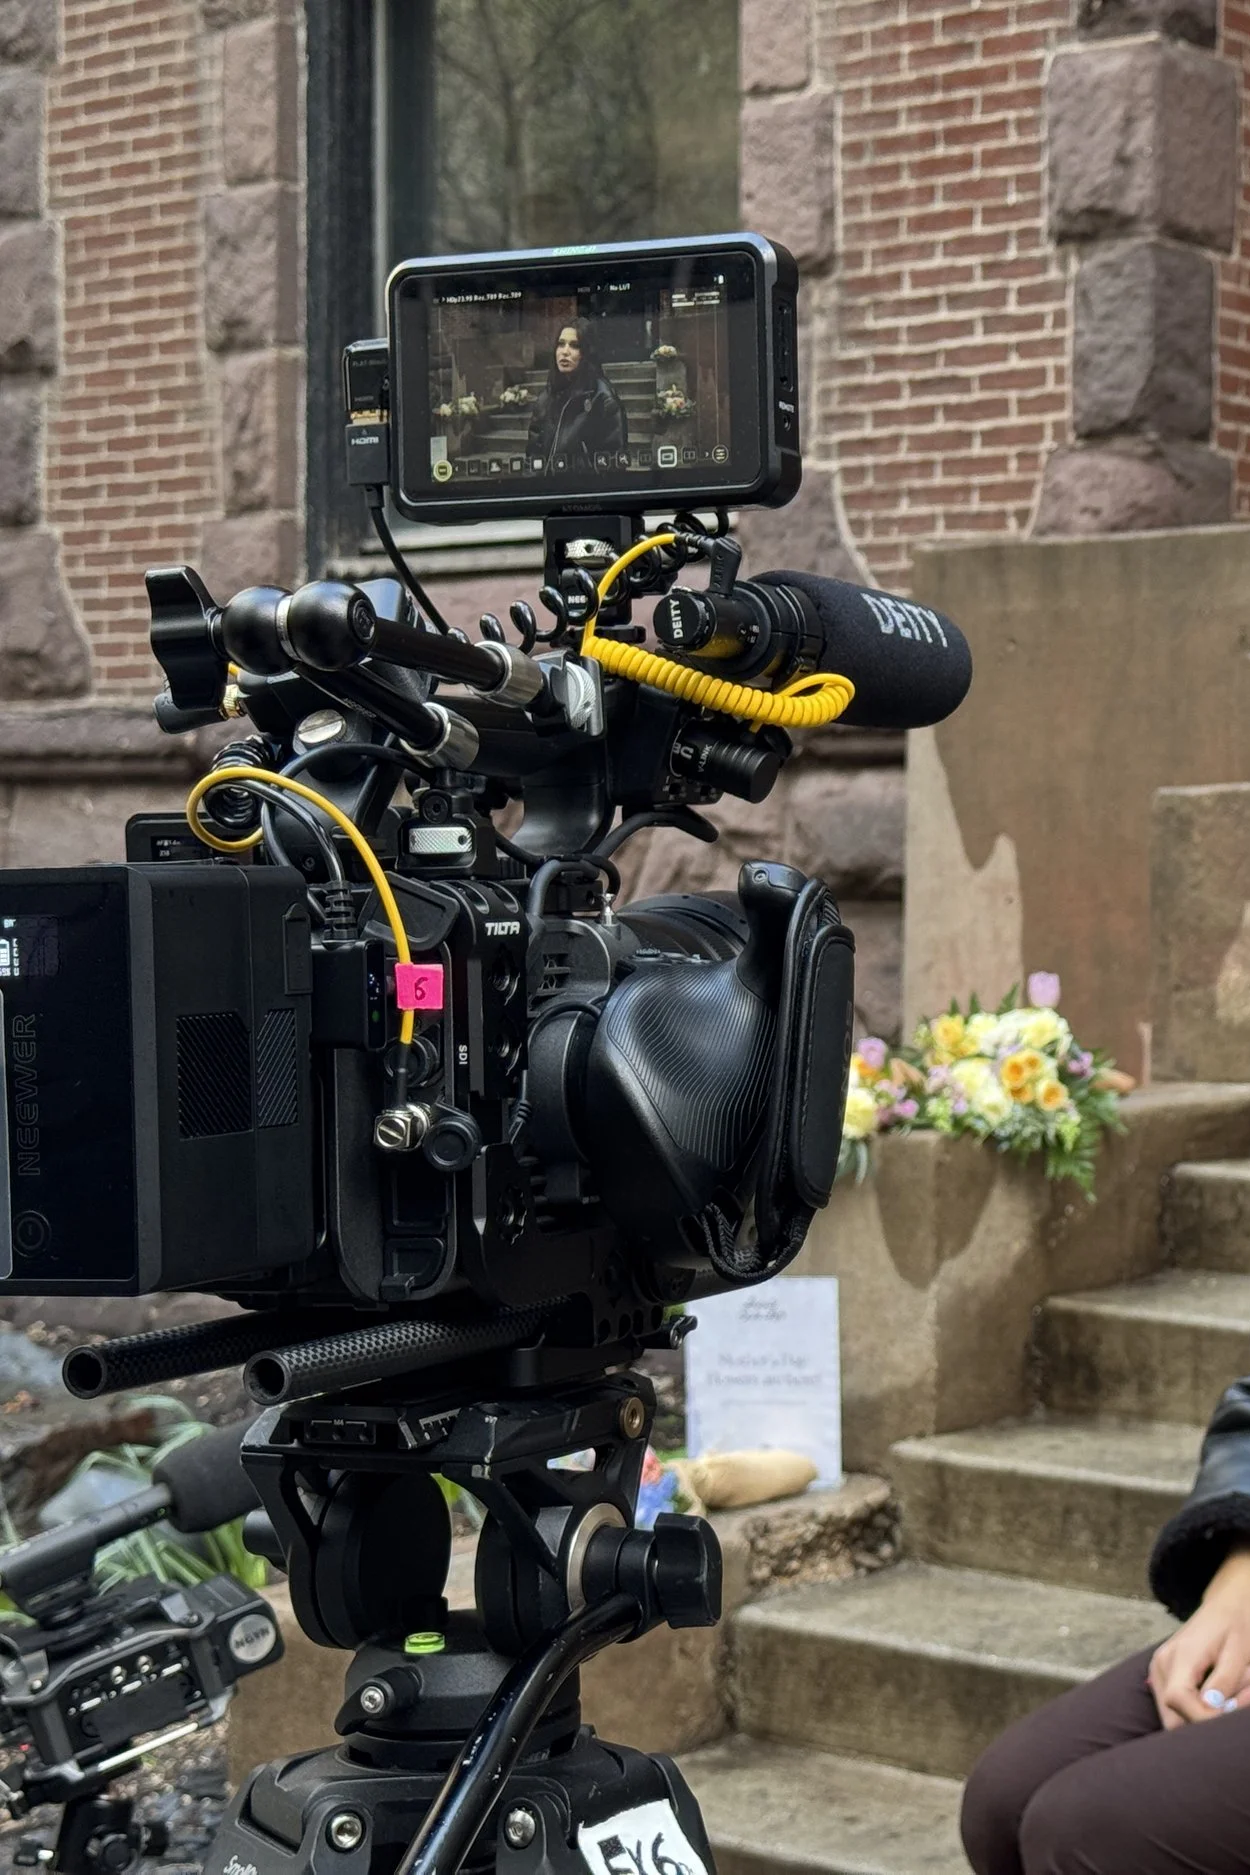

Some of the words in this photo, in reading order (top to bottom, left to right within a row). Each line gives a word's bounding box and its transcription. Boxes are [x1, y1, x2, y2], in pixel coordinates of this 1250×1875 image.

[351, 436, 379, 446] HDMI
[567, 594, 588, 604] NEE
[669, 598, 684, 639] DEITY
[860, 592, 948, 648] DEITY
[697, 743, 713, 773] V-LINK
[485, 921, 521, 936] TILTA
[414, 976, 429, 1001] 6
[458, 1044, 468, 1065] SDI
[12, 1013, 41, 1176] NEEWER
